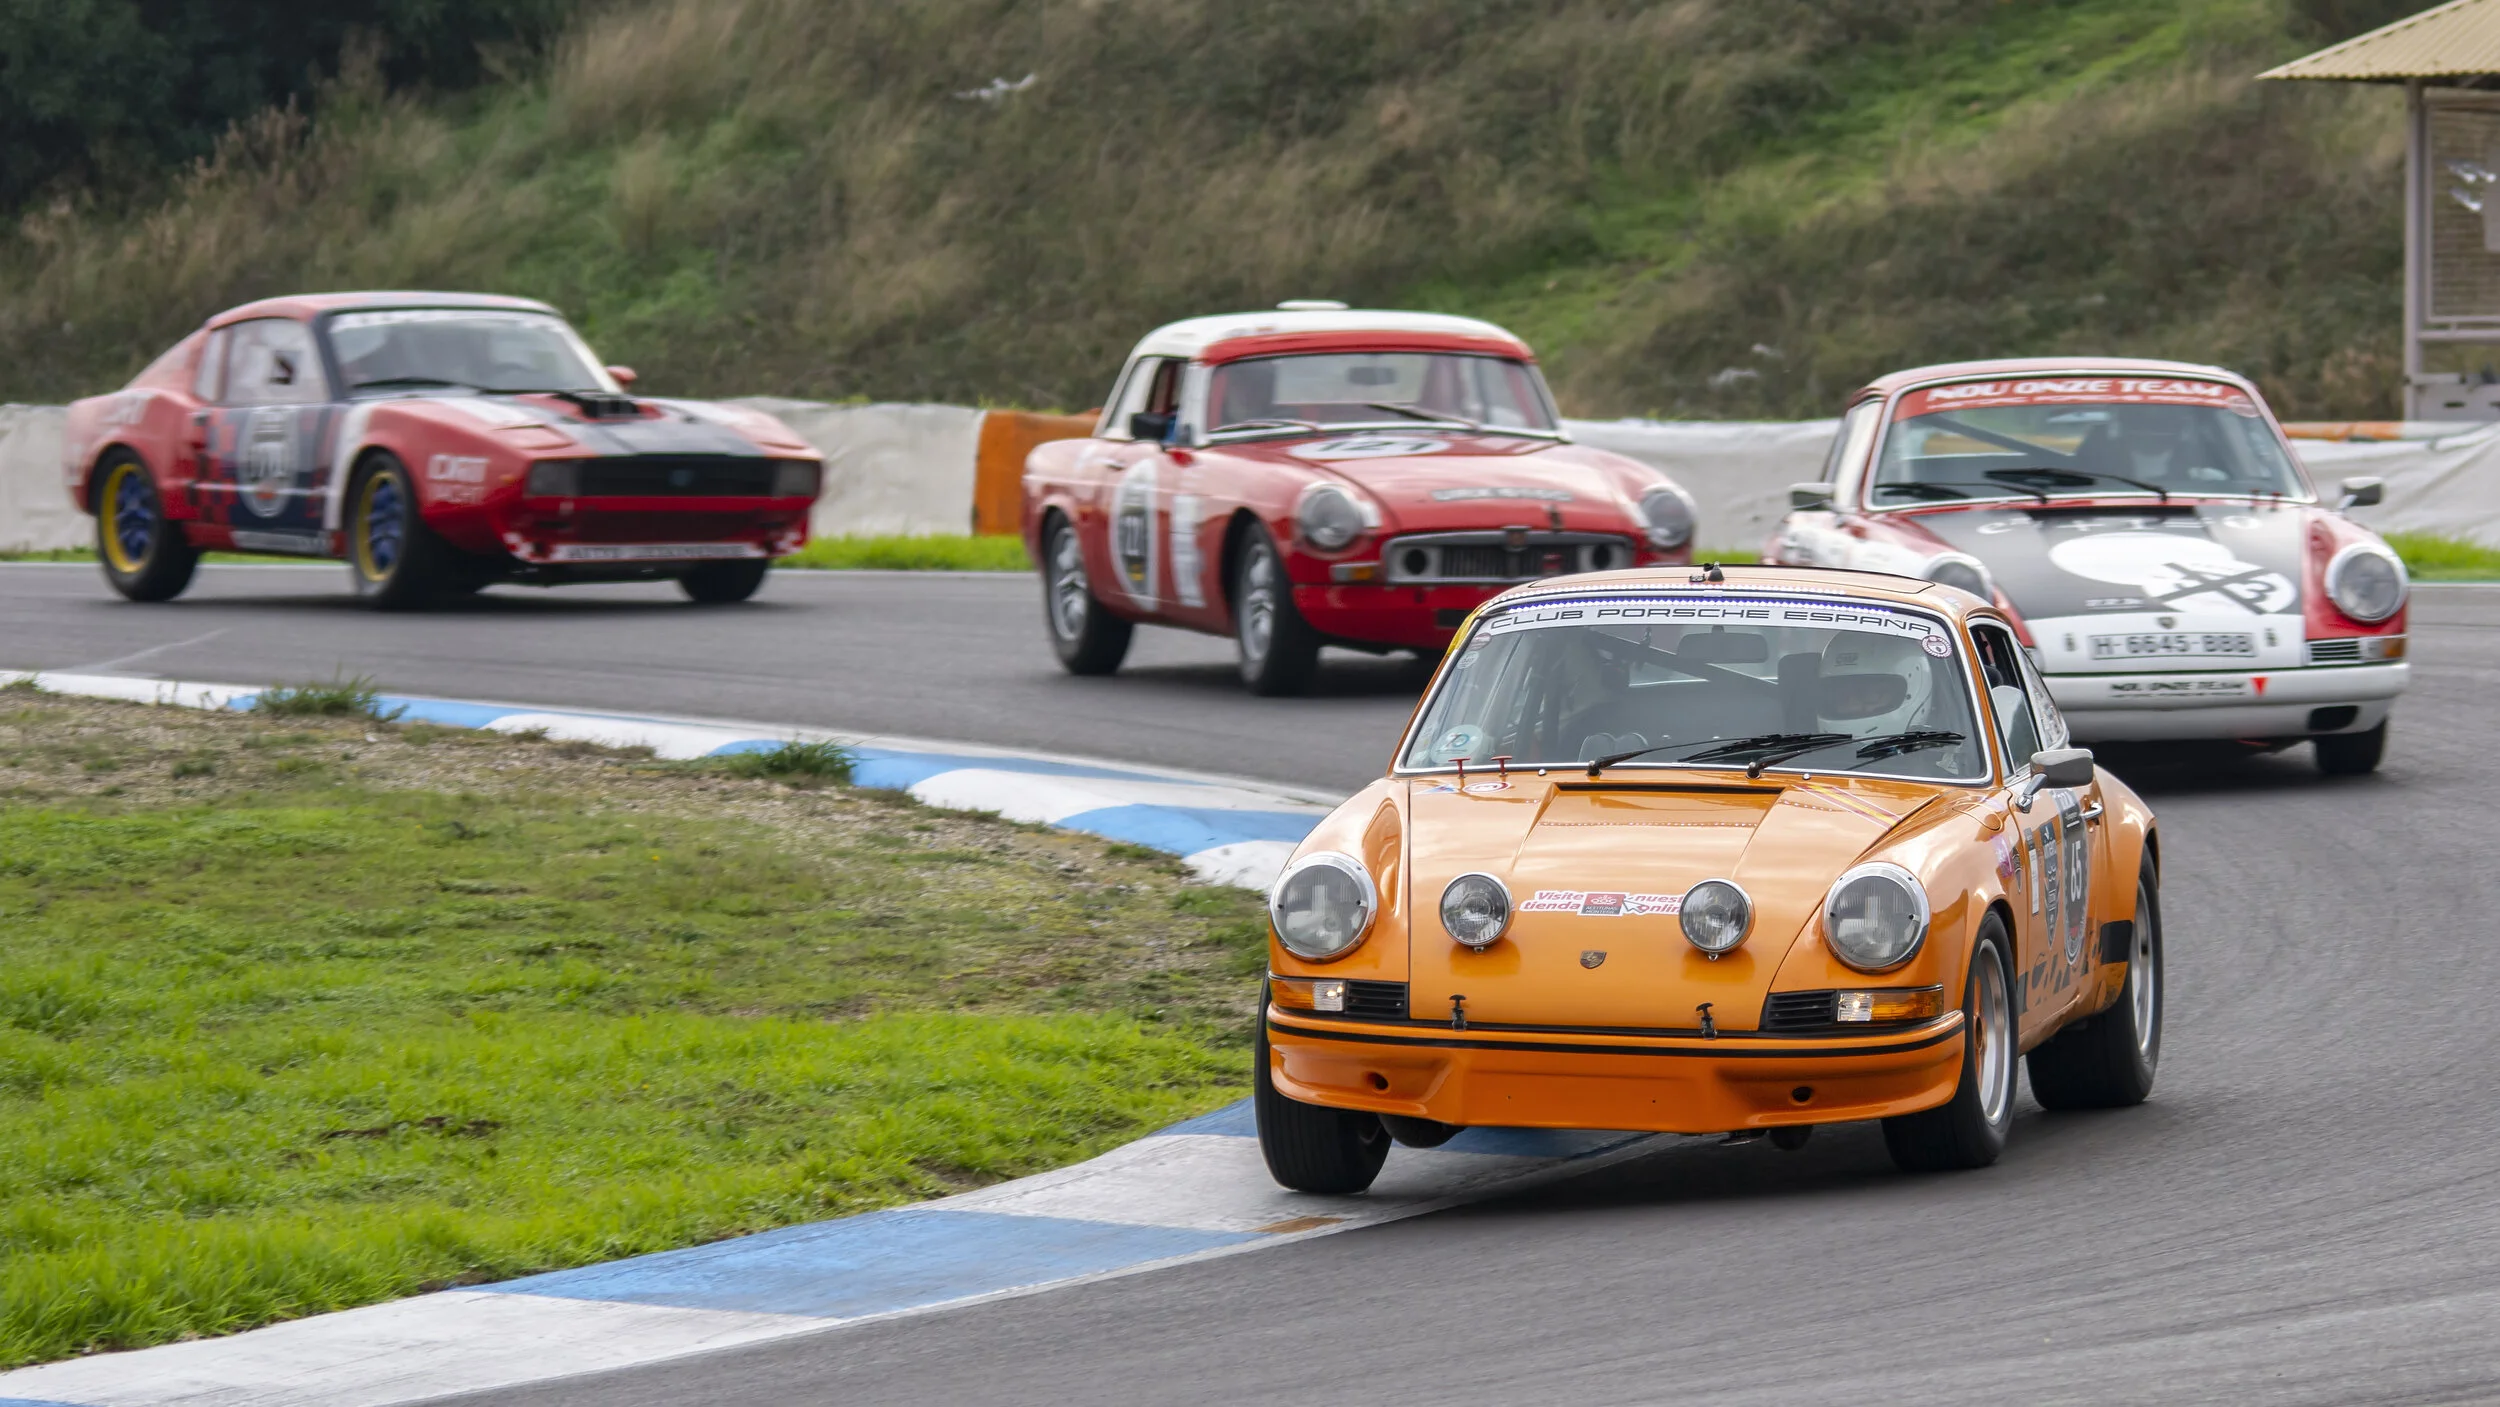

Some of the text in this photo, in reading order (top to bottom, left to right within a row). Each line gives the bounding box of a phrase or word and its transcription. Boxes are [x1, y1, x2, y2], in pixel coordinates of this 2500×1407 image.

[1927, 380, 2224, 401] NOU ONZE TEAM
[1491, 608, 1932, 635] CLUB PORSCHE ESPAÑA
[2070, 840, 2082, 902] 65
[1523, 900, 1581, 910] tienda
[1537, 892, 1685, 903] Visite nuest
